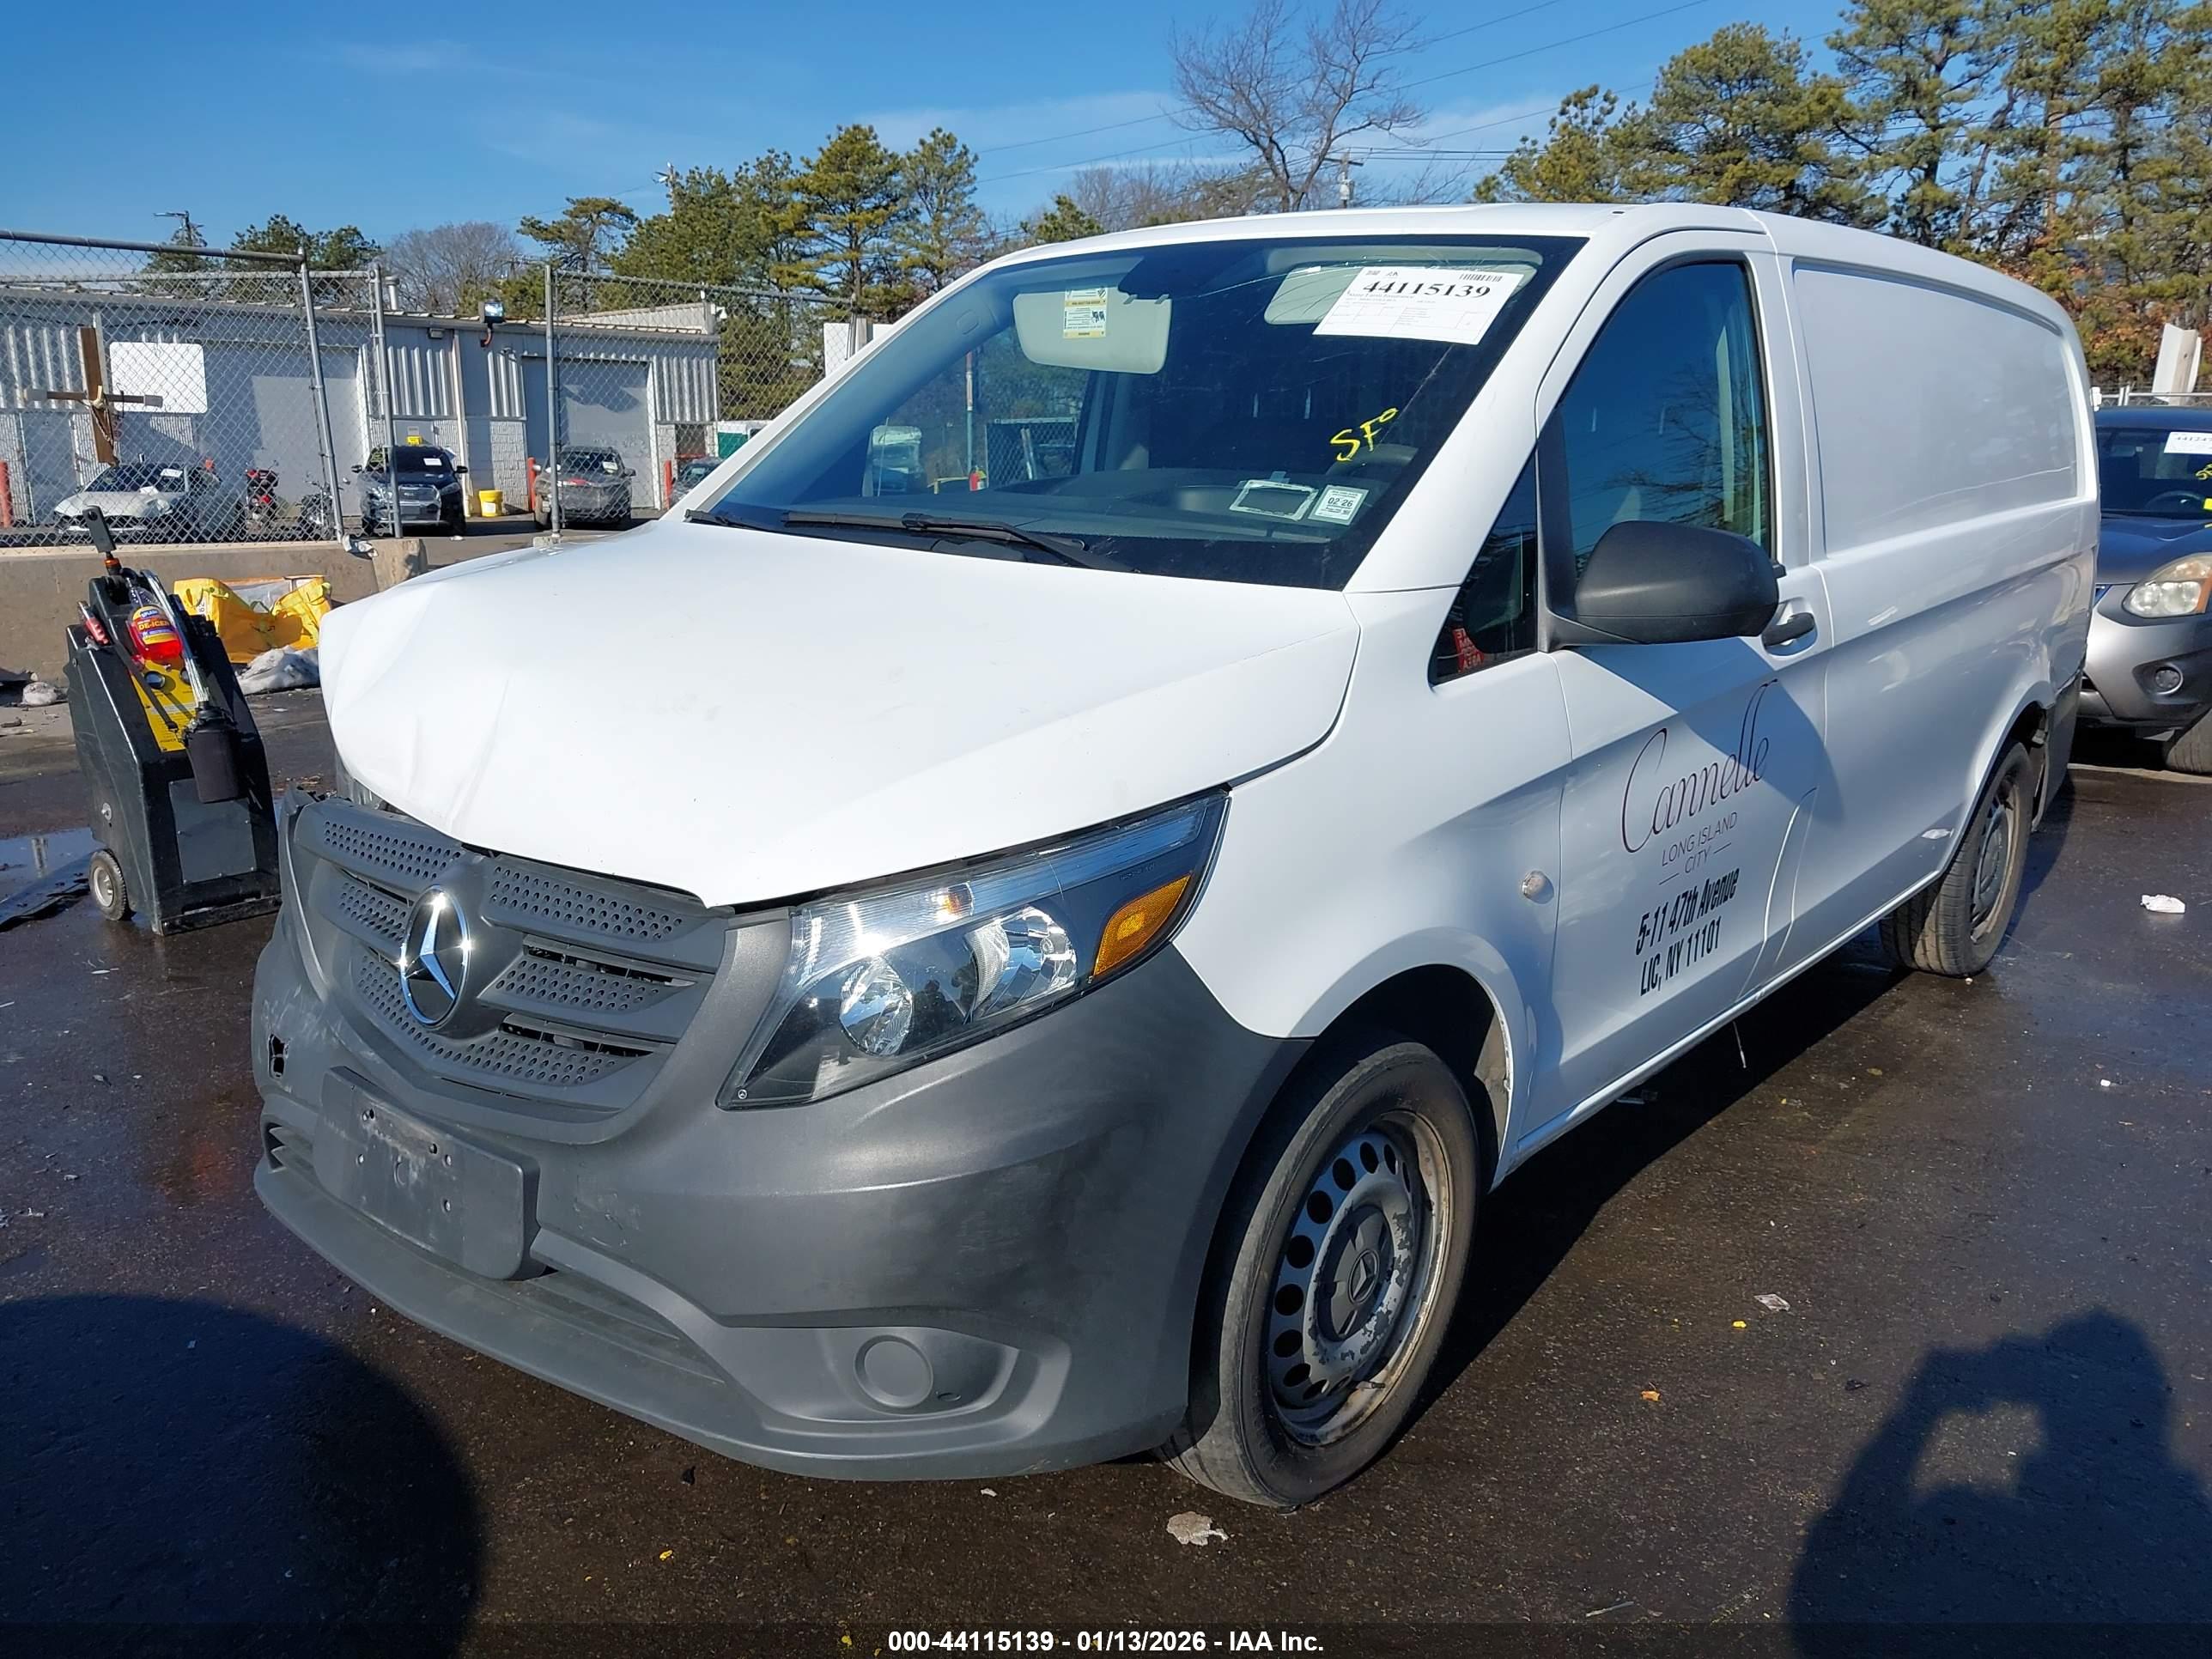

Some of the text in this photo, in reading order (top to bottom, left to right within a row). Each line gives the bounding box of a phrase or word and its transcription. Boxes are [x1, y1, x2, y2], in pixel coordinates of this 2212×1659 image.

[1363, 281, 1491, 298] 44115139
[1622, 678, 1778, 853] Cannelle
[1662, 811, 1737, 866] LONG ISLAND
[1685, 846, 1711, 873] CITY
[1636, 868, 1740, 955] 5-11 47th Avenue
[1640, 916, 1721, 996] LIC, NY 11101
